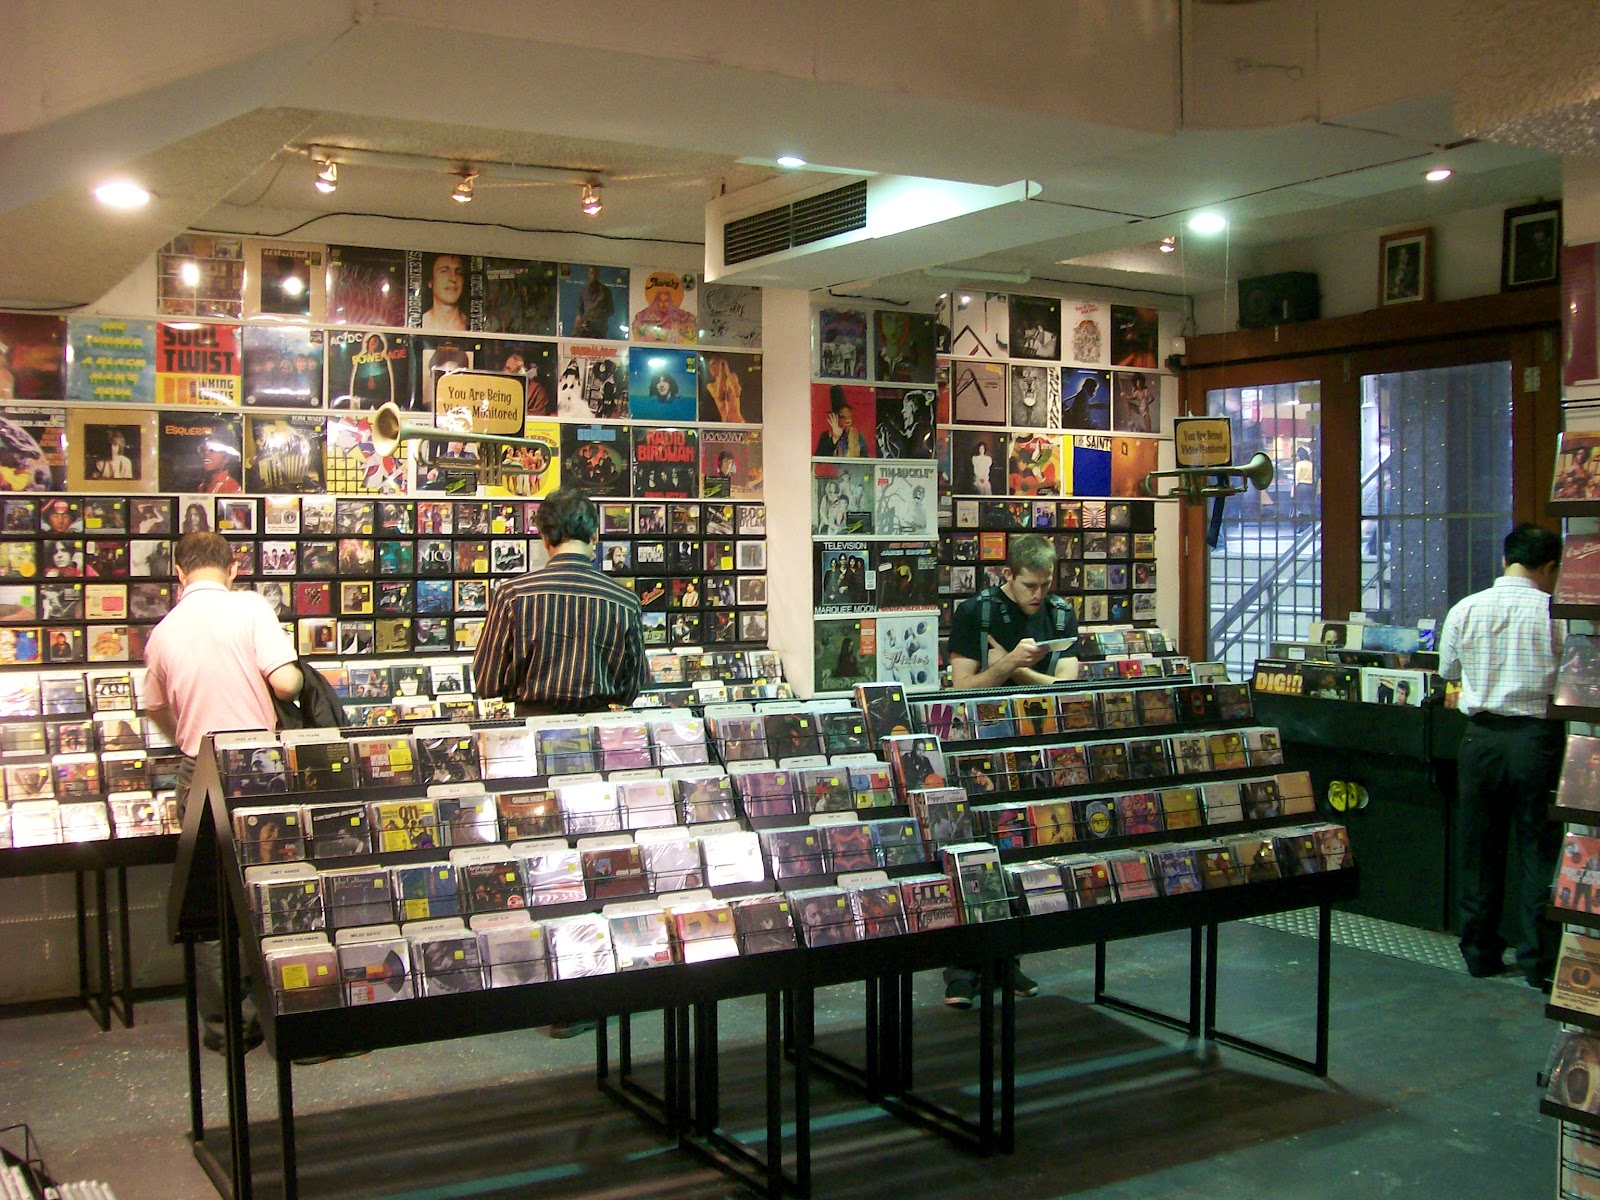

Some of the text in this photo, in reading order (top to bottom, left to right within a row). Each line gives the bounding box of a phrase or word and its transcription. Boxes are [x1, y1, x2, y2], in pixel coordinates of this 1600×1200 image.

[163, 324, 220, 348] SOUL
[163, 349, 234, 374] TWIST
[448, 386, 512, 405] You Are Being
[472, 405, 518, 420] Monitored
[646, 428, 686, 445] RADIO
[637, 444, 694, 462] BIRDMAN
[880, 467, 896, 478] TIM
[823, 541, 867, 551] TELEVISION
[418, 550, 452, 562] NICO
[815, 605, 853, 614] MARQUEE
[853, 605, 877, 613] MOON
